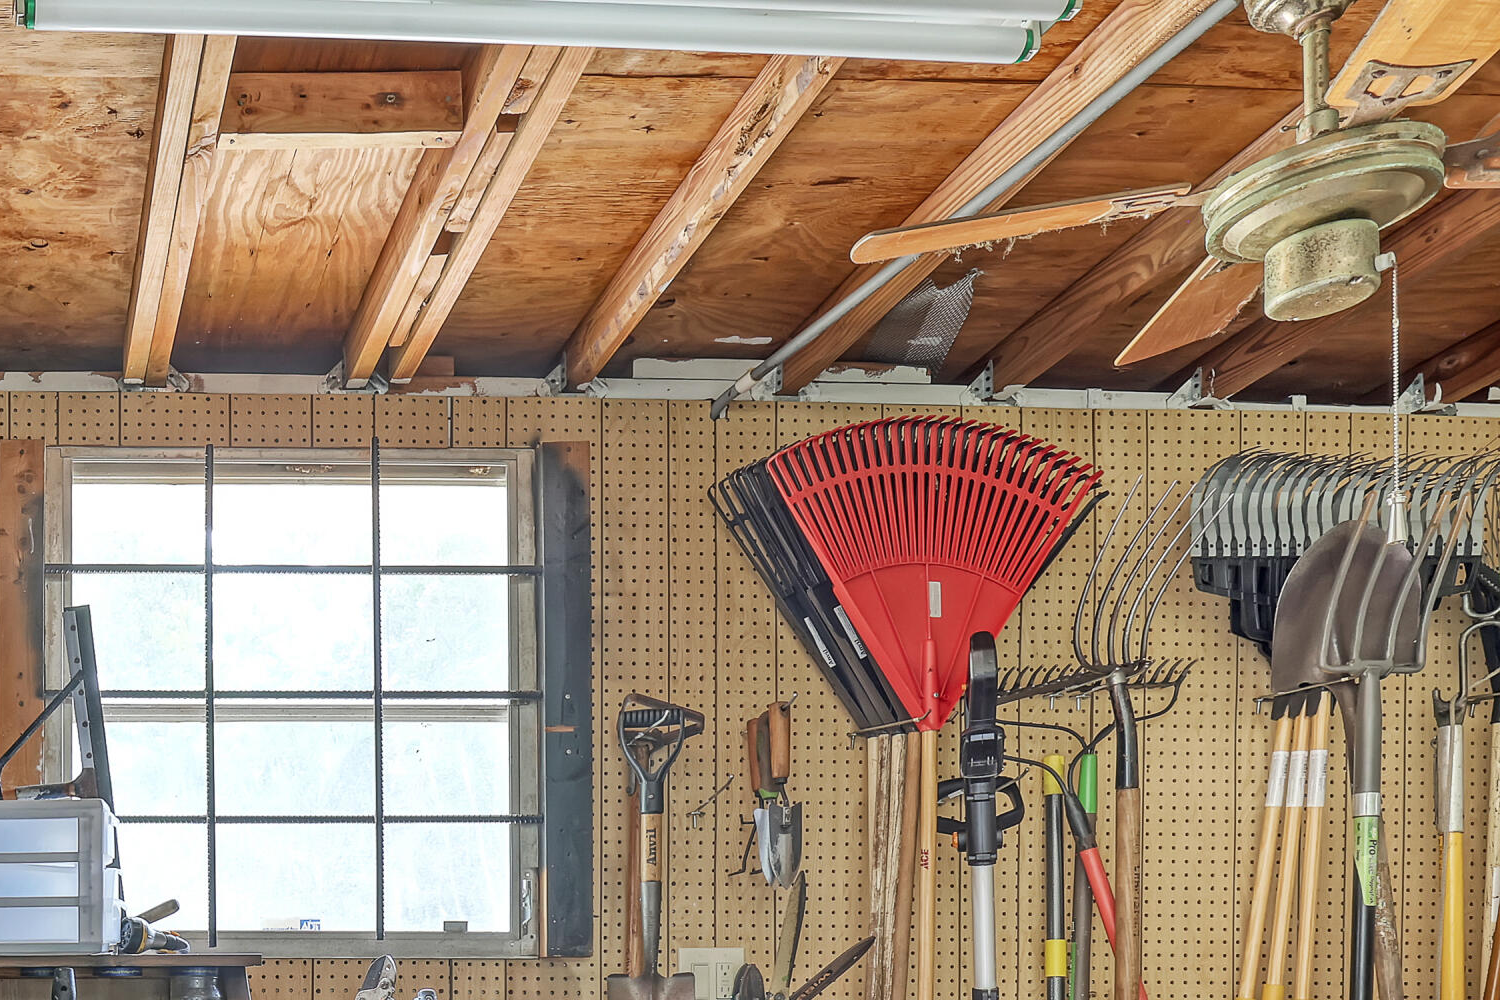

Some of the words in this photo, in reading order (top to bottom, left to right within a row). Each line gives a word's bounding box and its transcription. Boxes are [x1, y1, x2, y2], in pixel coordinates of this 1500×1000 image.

[646, 828, 656, 866] Anvil
[920, 849, 929, 870] ACE
[300, 920, 320, 931] ADT
